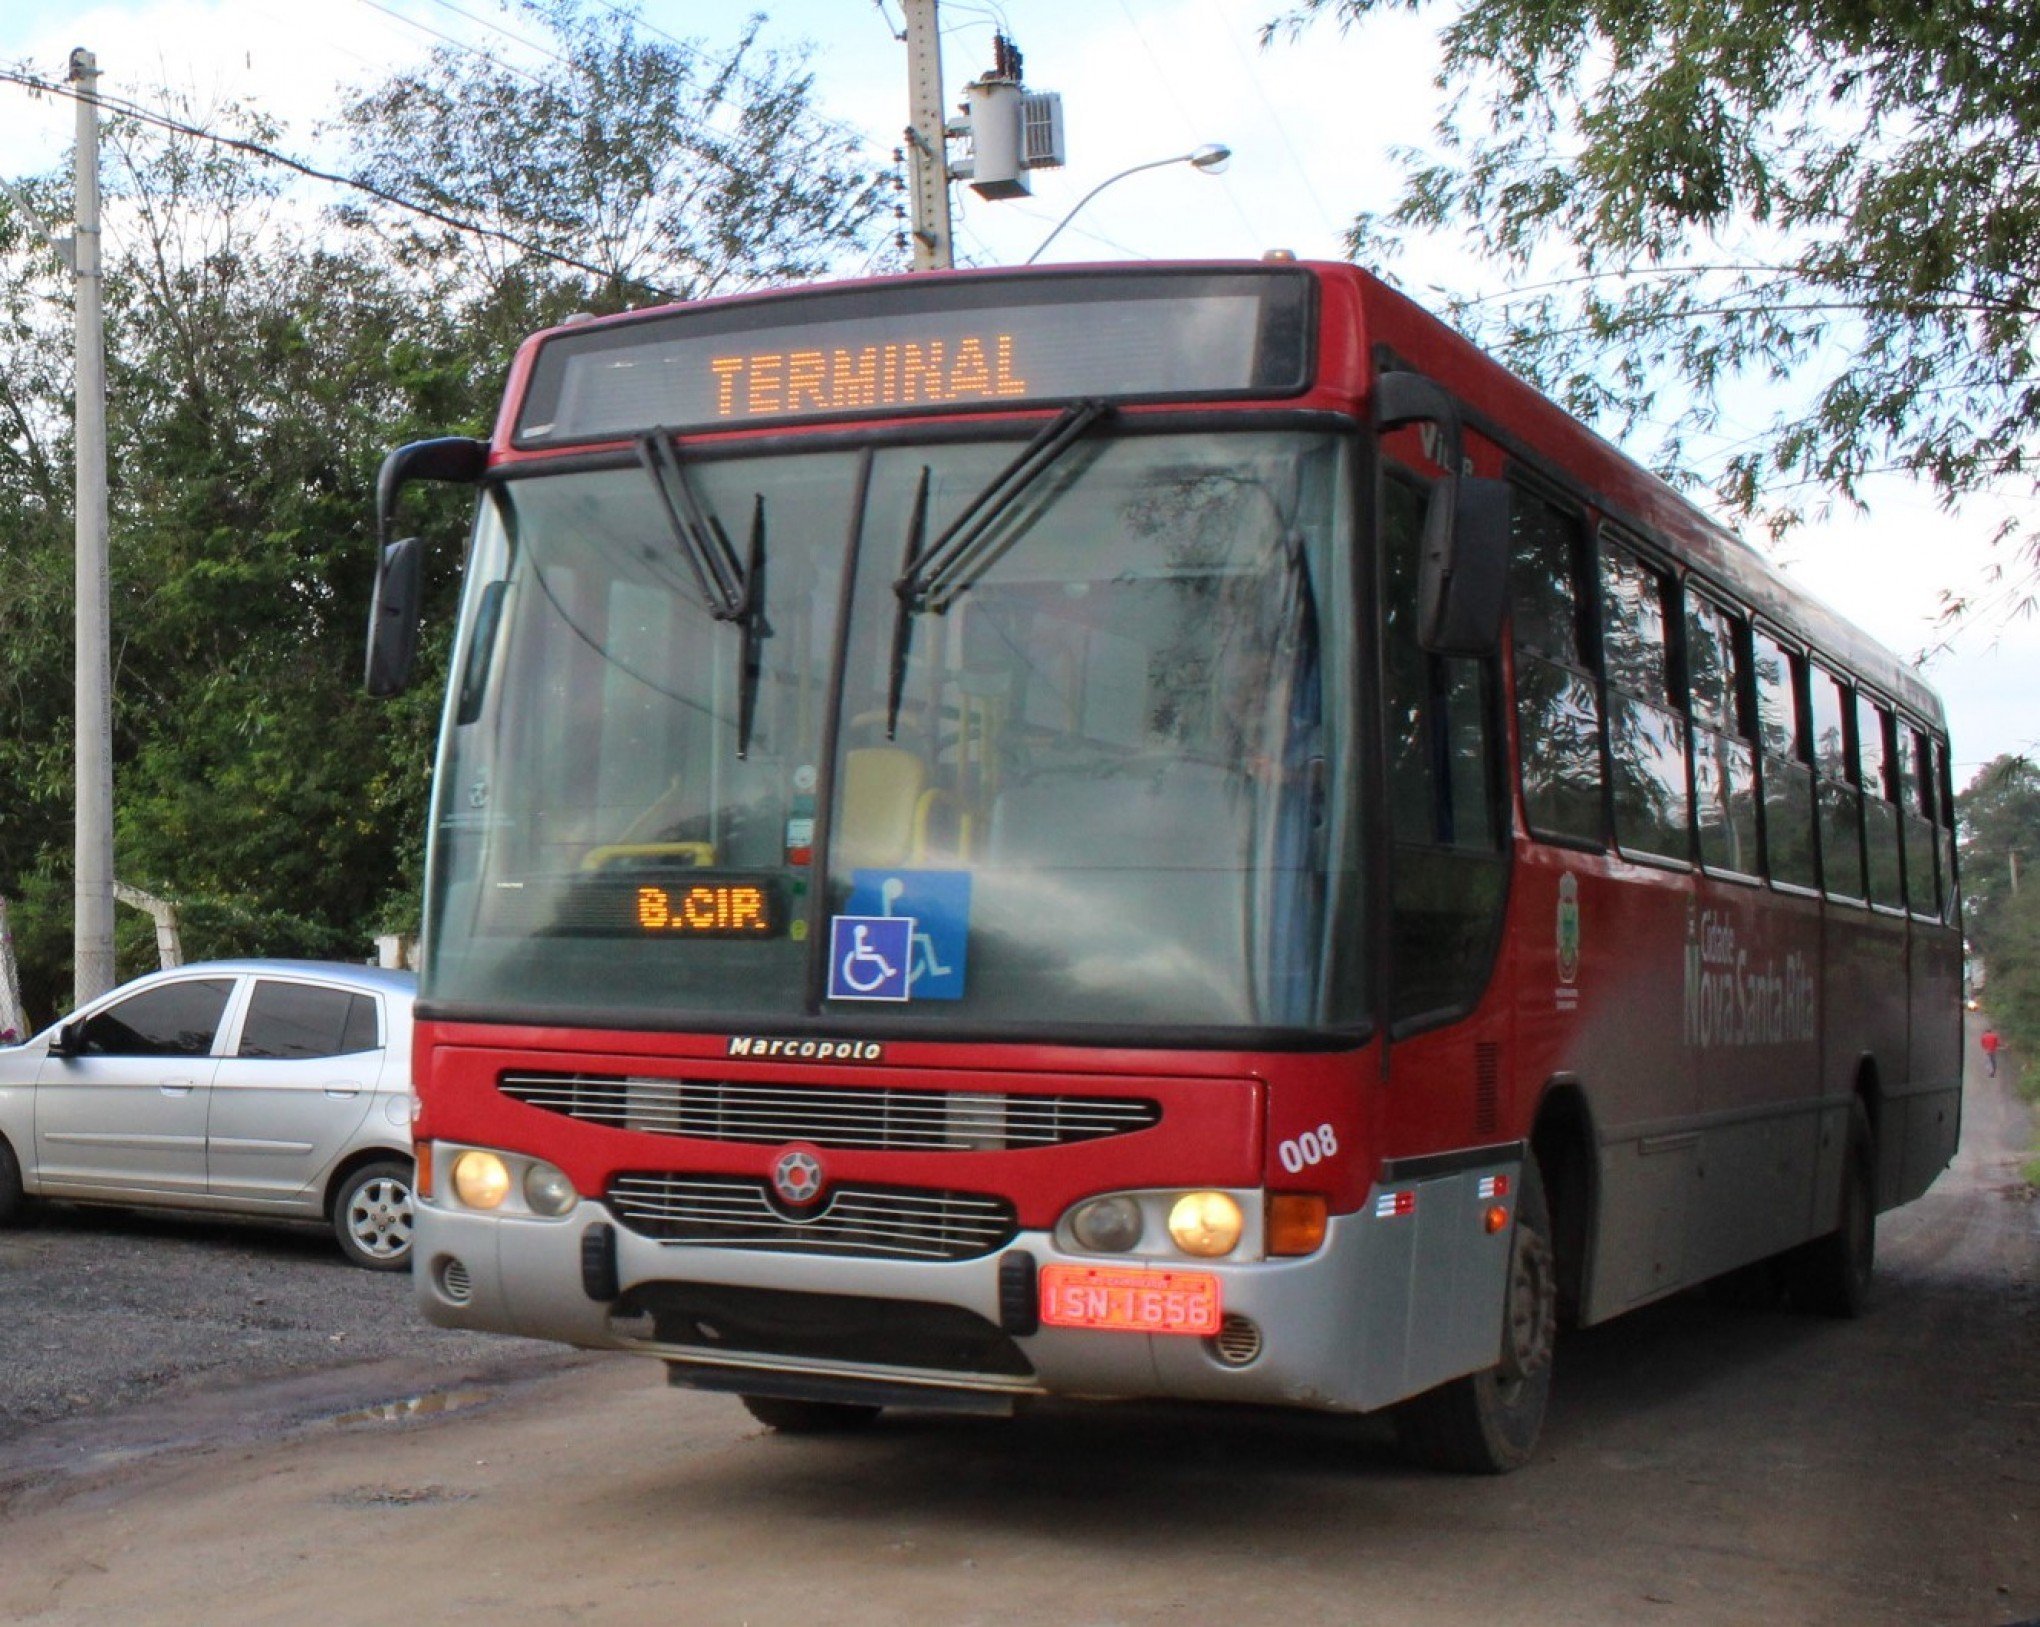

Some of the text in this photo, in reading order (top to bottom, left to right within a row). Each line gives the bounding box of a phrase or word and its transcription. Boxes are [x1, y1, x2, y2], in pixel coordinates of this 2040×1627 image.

[711, 335, 1027, 416] TERMINAL
[729, 1036, 882, 1060] Marcopolo
[1279, 1123, 1339, 1174] 008
